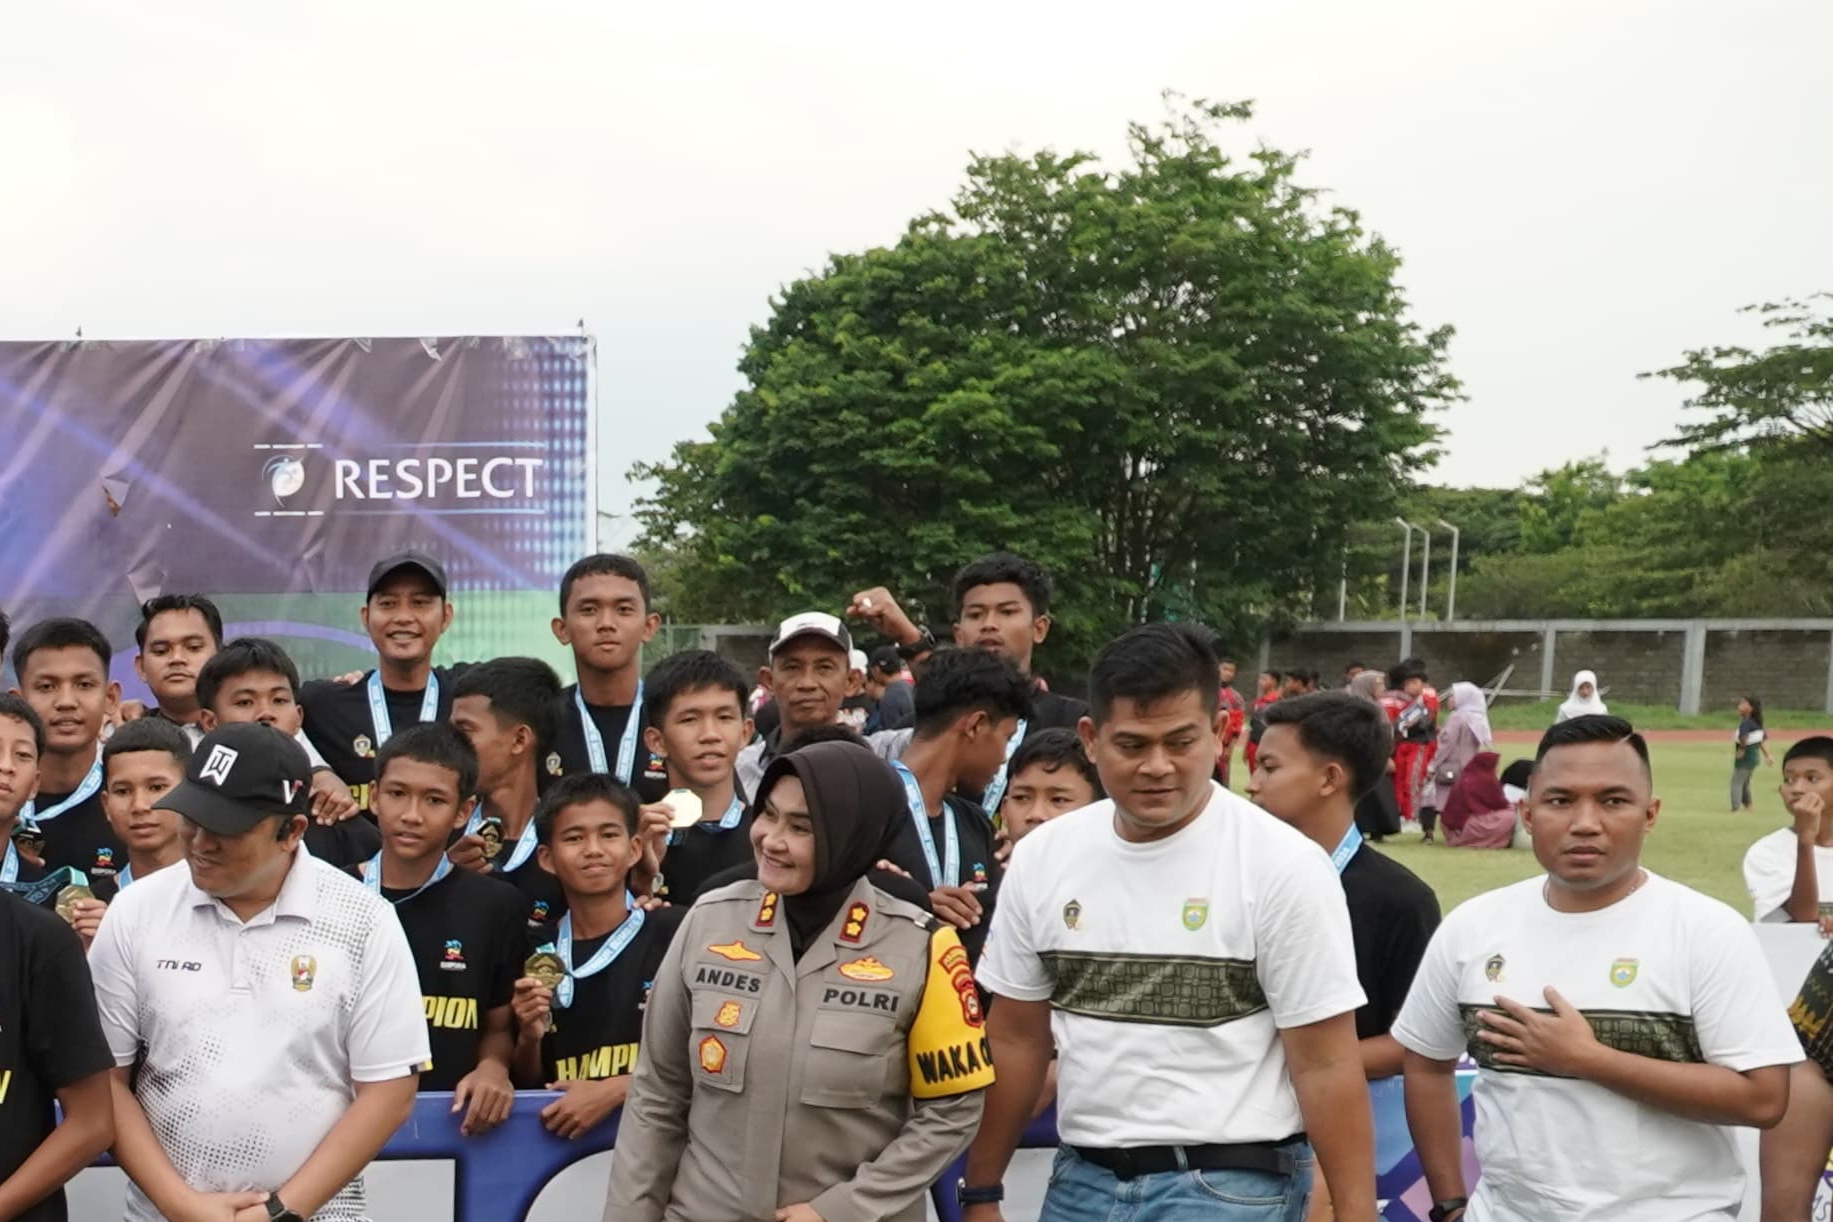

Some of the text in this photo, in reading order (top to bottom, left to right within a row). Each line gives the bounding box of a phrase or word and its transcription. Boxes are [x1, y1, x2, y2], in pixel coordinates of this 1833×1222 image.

[334, 457, 543, 500] RESPECT
[156, 959, 180, 970] TNI
[695, 967, 761, 993] ANDES
[823, 988, 899, 1013] POLRI
[916, 1042, 982, 1085] WAKA
